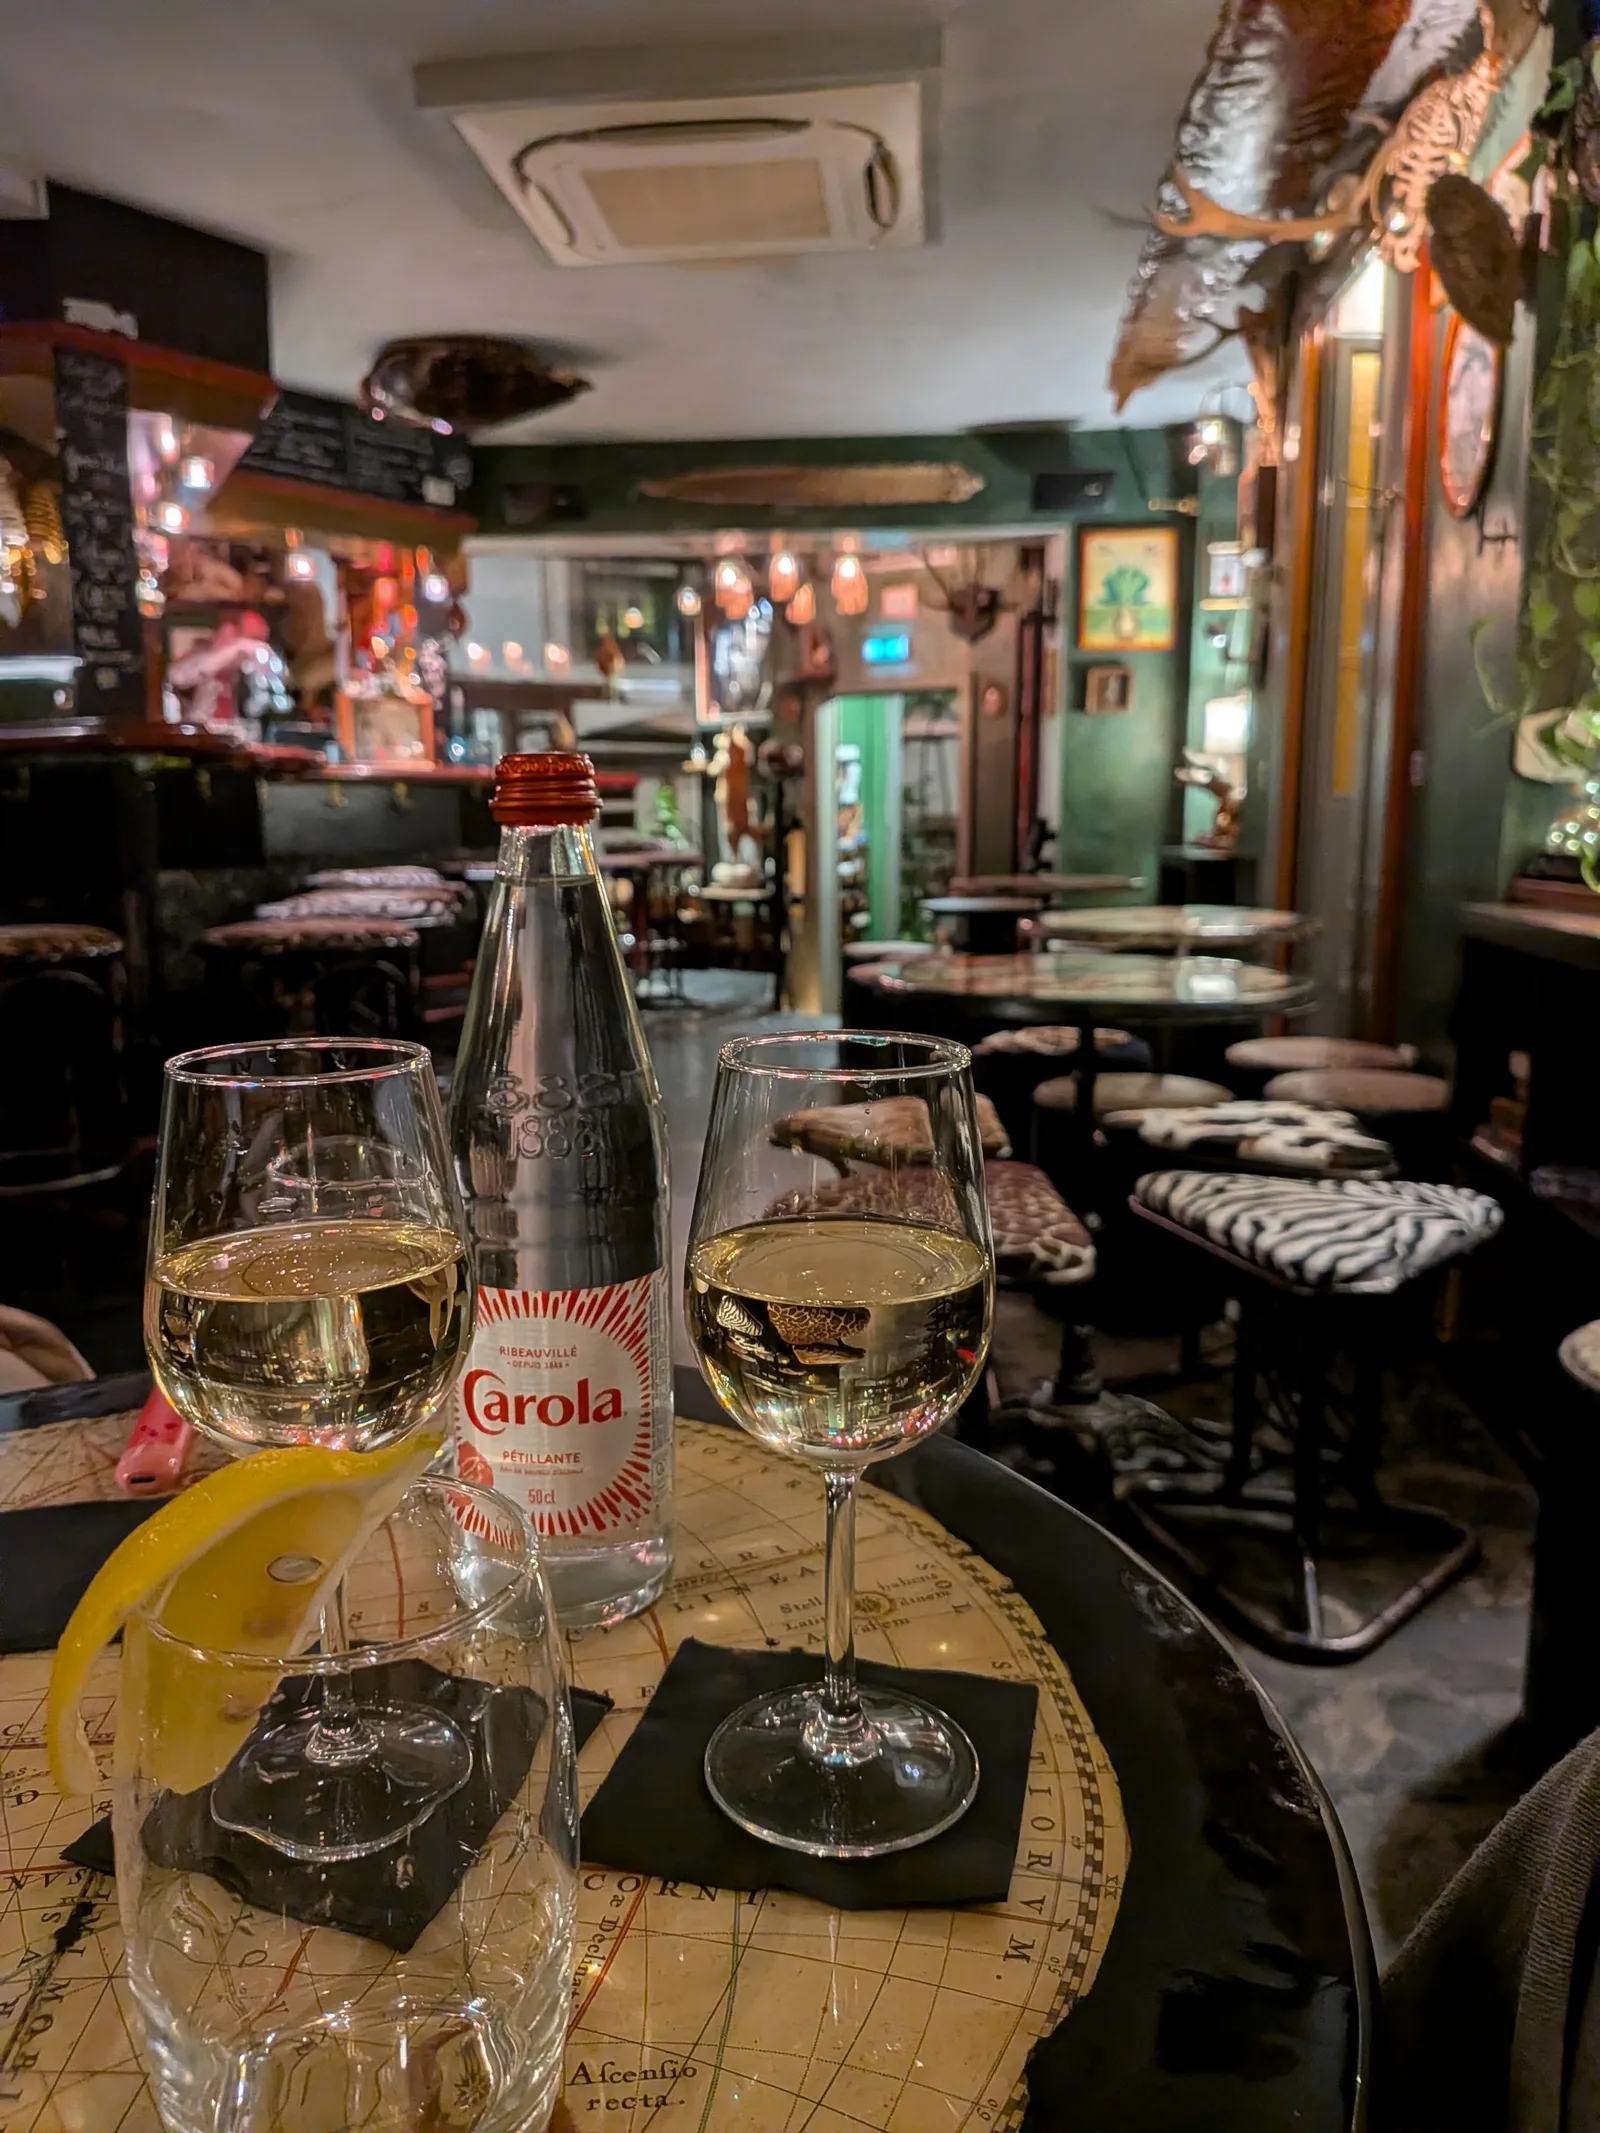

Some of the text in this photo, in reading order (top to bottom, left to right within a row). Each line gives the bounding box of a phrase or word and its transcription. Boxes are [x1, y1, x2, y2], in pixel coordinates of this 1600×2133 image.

[499, 1344, 578, 1359] RIBEAUVILLÉ
[463, 1369, 623, 1435] Carola
[503, 1449, 582, 1464] PÉTILLANTE
